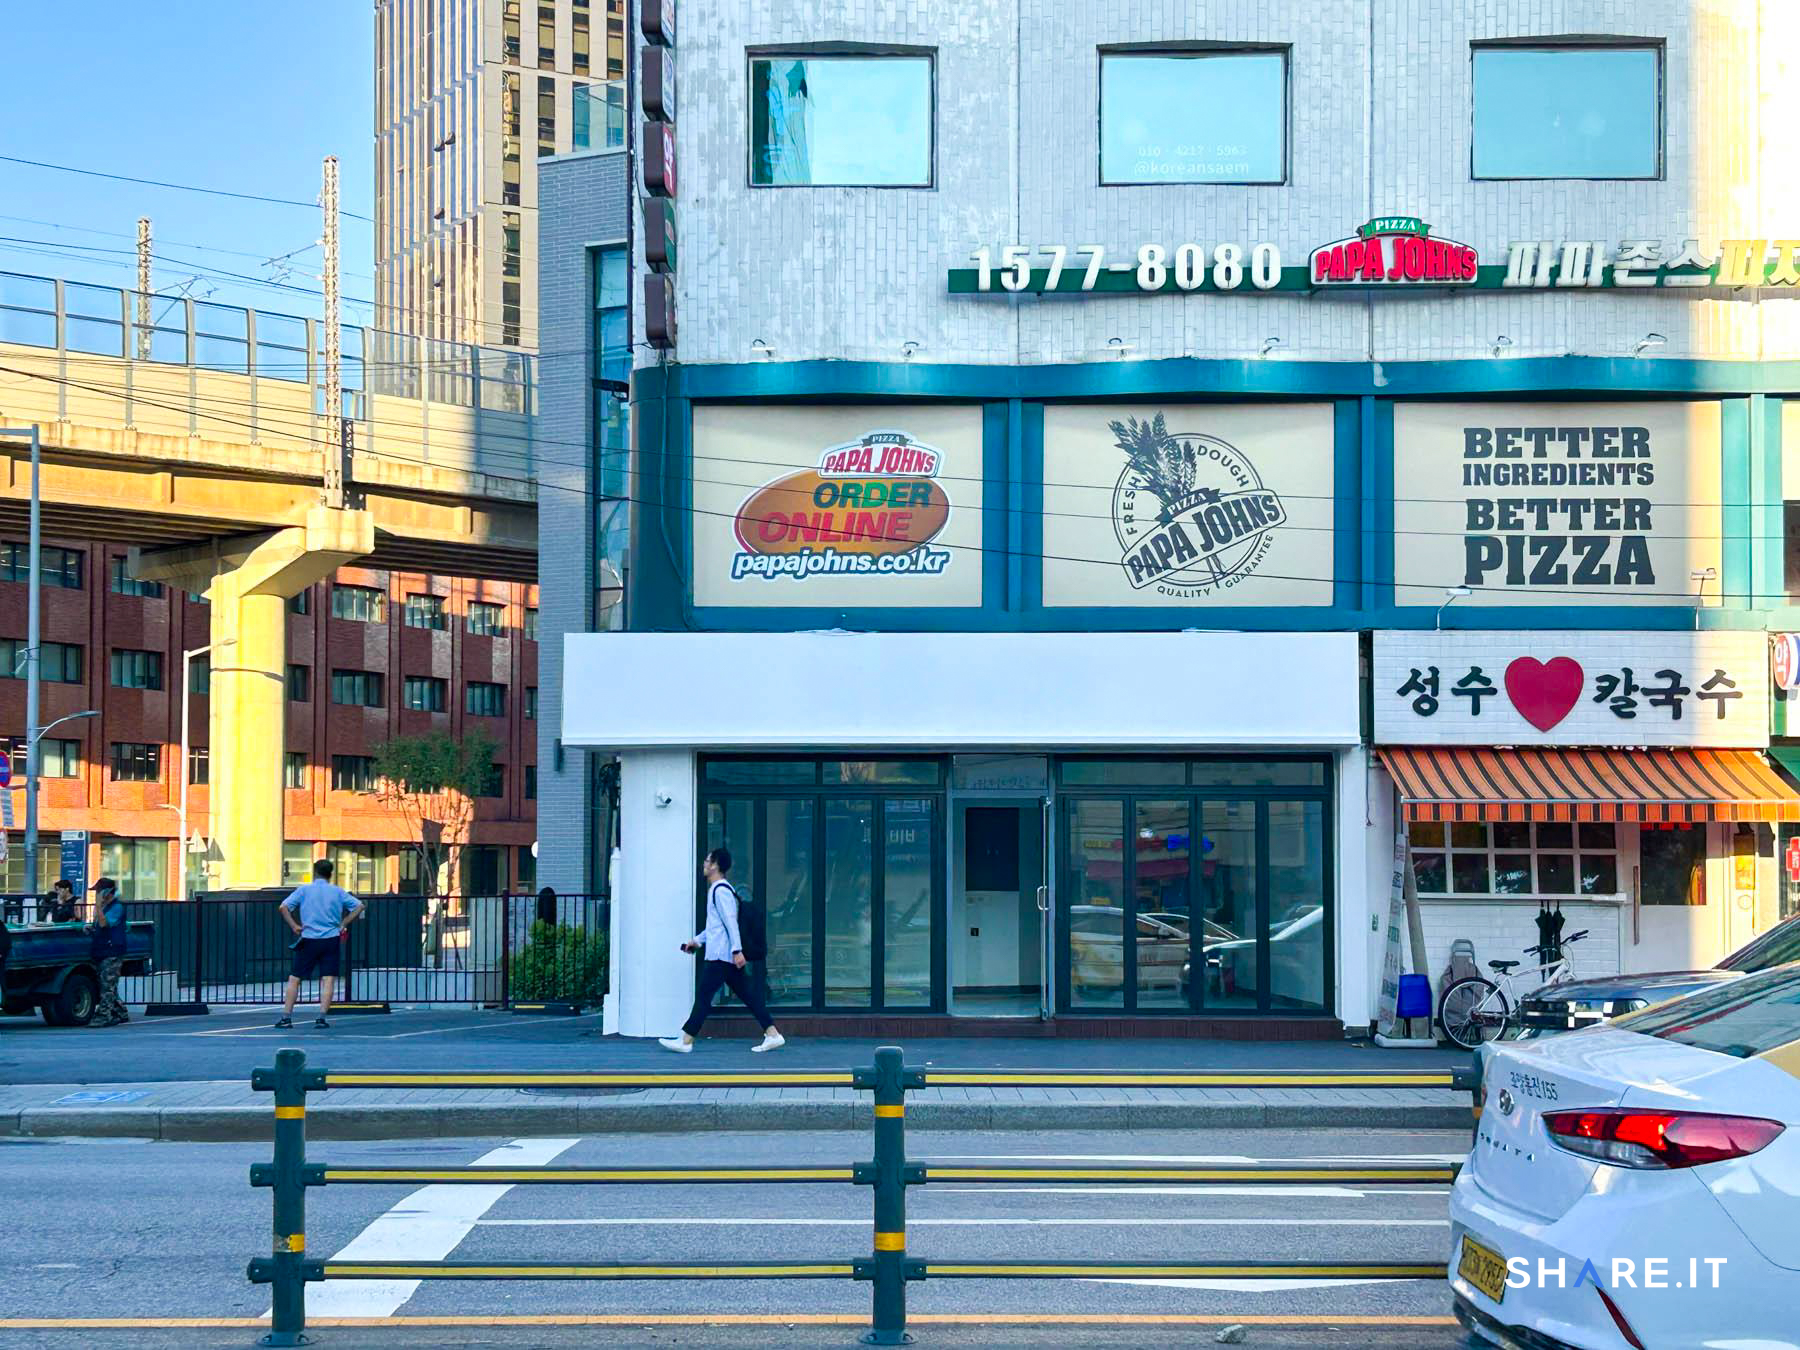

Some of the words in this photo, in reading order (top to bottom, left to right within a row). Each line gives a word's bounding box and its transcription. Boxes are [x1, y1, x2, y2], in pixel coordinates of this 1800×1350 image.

[1134, 160, 1249, 177] @koreansaem
[1375, 219, 1416, 231] PIZZA
[970, 243, 1281, 291] 1577-8080
[1315, 238, 1385, 282] PAPA
[872, 434, 902, 443] PIZZA
[1463, 427, 1651, 459] BETTER
[824, 447, 872, 473] PAPA
[1463, 463, 1655, 486] INGREDIENTS
[812, 481, 933, 509] ORDER
[1123, 476, 1142, 536] FRESH
[1197, 445, 1249, 488] DOUGH
[1167, 491, 1209, 515] PIZZA
[757, 511, 913, 544] ONLINE
[1465, 498, 1652, 531] BETTER
[734, 546, 948, 577] papajohns.co.kr
[1127, 521, 1199, 584] PAPA
[1157, 585, 1211, 598] QUALITY
[1225, 534, 1274, 588] GUARANTEE
[1464, 536, 1655, 585] PIZZA
[1396, 666, 1498, 717] 성수
[1592, 667, 1743, 720] 칼국수
